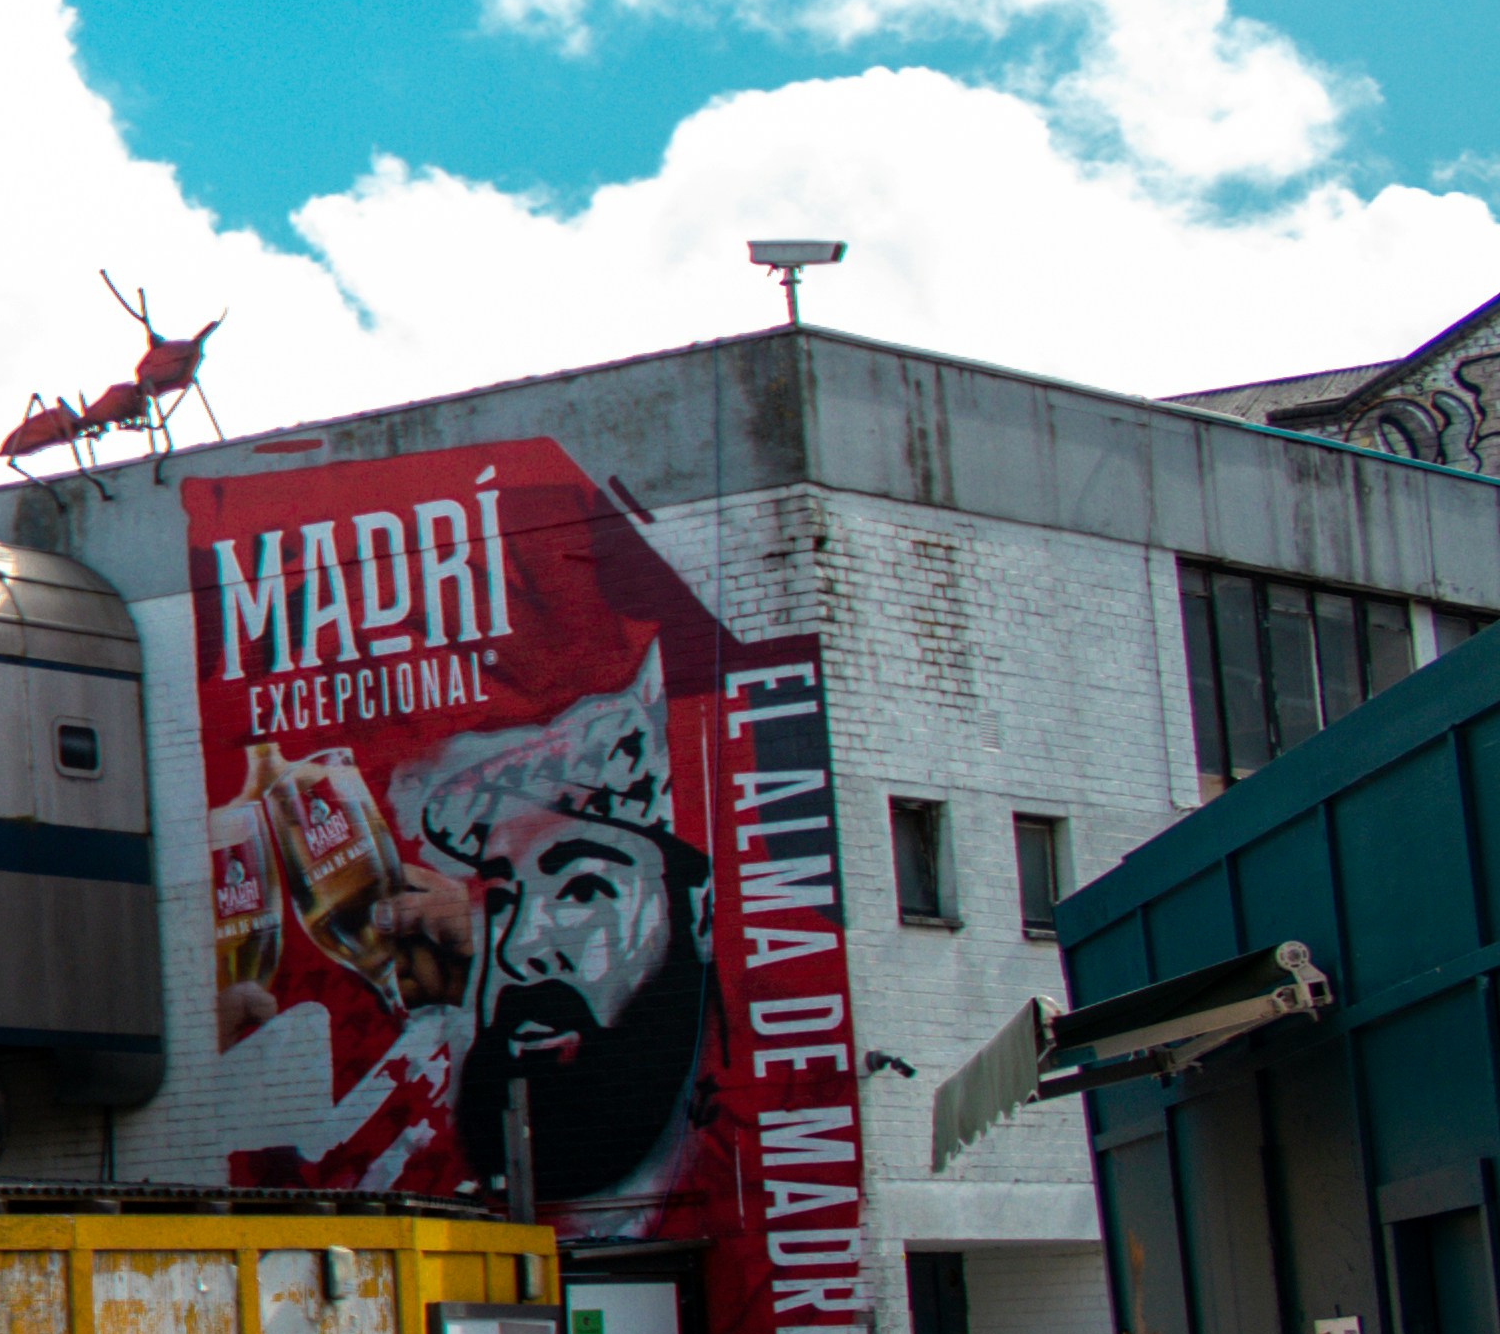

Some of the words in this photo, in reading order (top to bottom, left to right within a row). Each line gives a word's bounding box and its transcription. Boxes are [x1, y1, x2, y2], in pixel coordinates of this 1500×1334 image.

[213, 465, 512, 680] MADRÍ
[250, 652, 489, 736] EXCEPCIONAL
[725, 661, 819, 740] EL
[732, 769, 838, 968] ALMA
[749, 993, 849, 1078] DE
